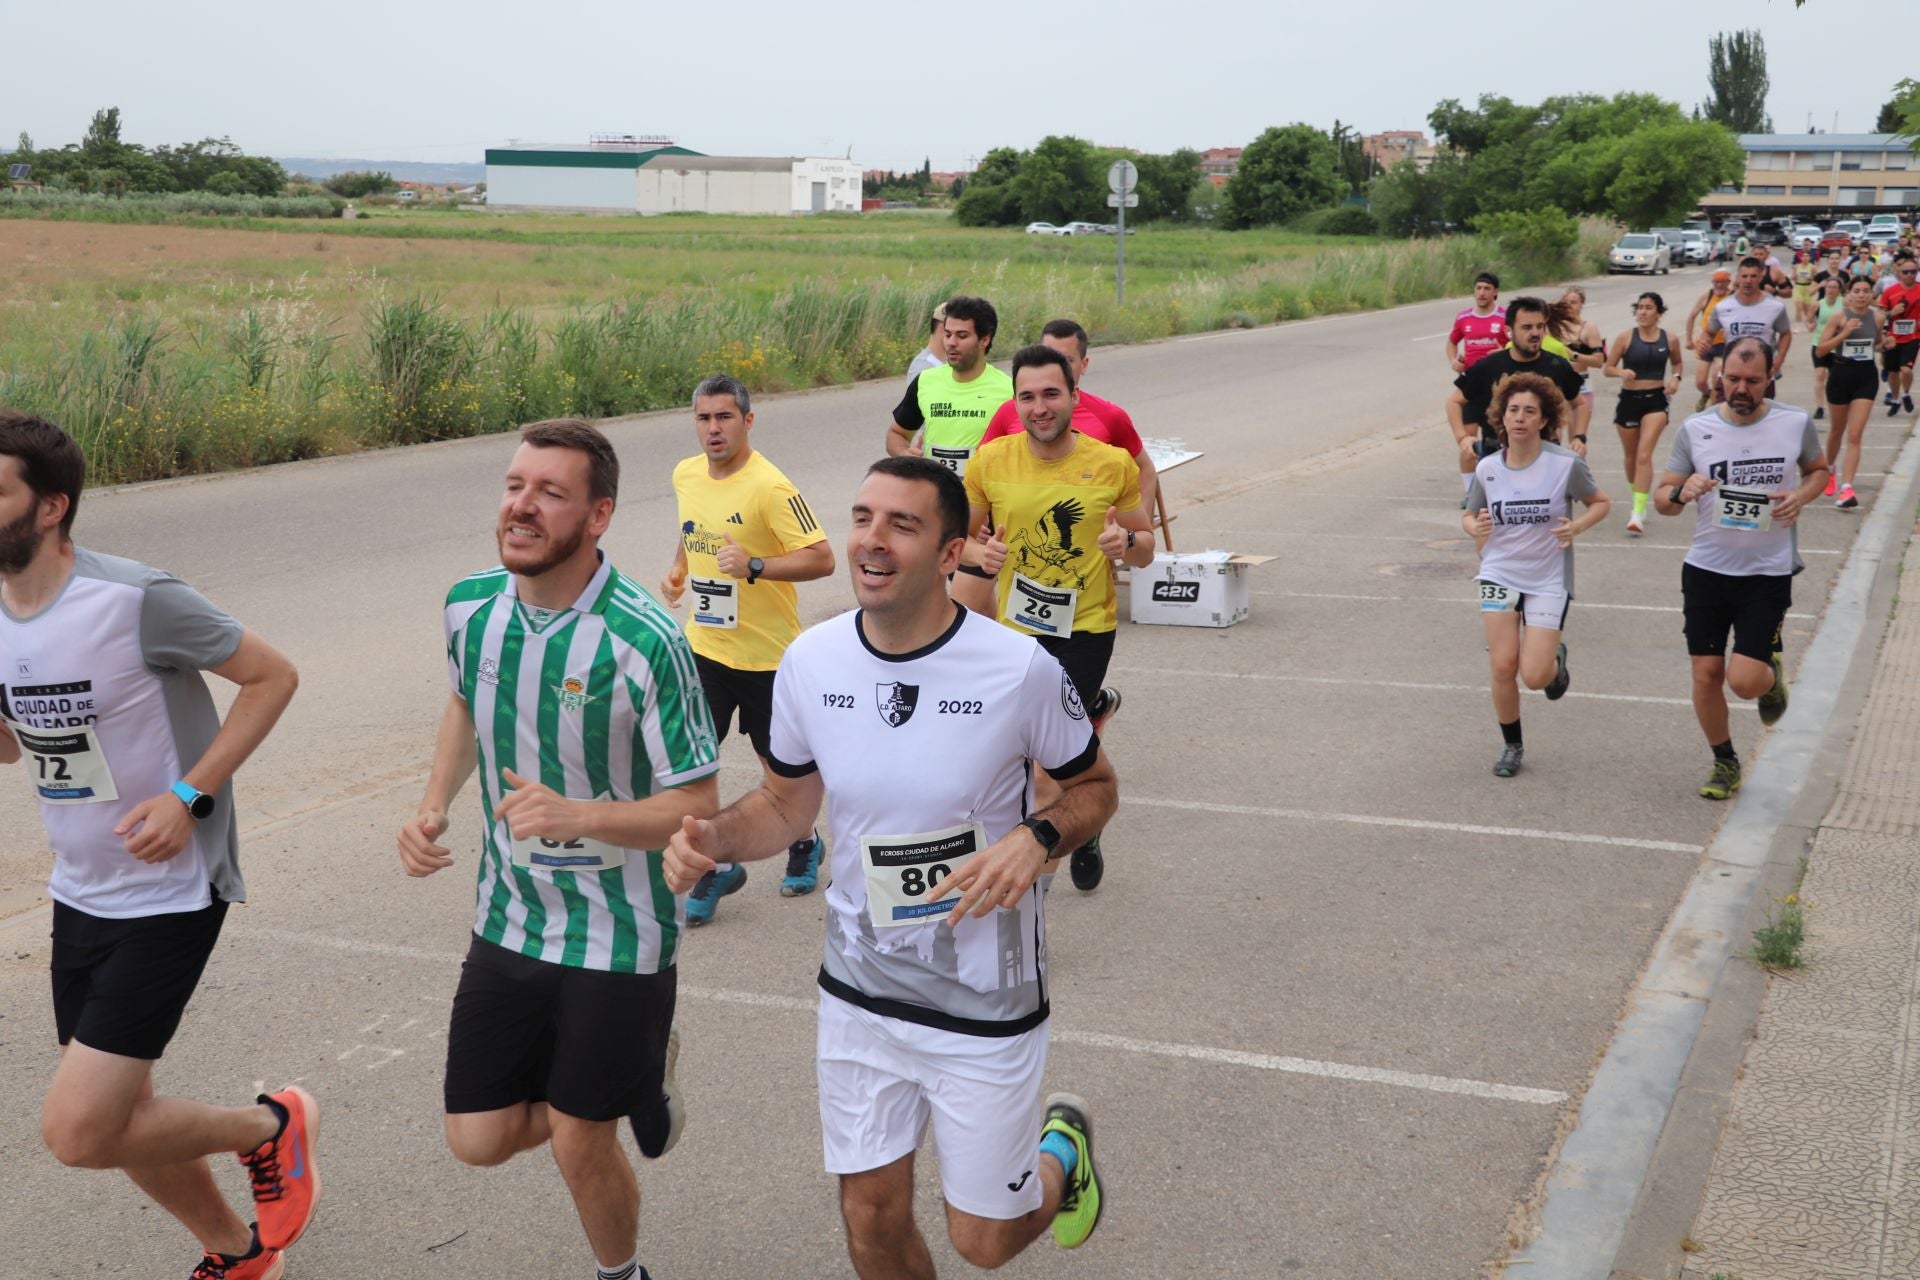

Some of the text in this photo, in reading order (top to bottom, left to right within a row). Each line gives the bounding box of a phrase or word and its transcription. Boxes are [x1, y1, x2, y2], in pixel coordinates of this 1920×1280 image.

[930, 402, 952, 410] CURSA
[1732, 465, 1773, 476] CIUDAD
[1732, 474, 1784, 486] ALFARO
[1504, 506, 1540, 515] CIUDAD
[1723, 501, 1761, 518] 534
[1507, 515, 1551, 525] ALFARO
[690, 540, 718, 556] WORLD
[1155, 585, 1197, 598] 42K
[699, 595, 710, 611] 3
[1024, 598, 1052, 619] 26
[15, 698, 94, 715] CIUDAD DE
[822, 693, 855, 709] 1922
[891, 704, 913, 712] ALFARO
[938, 700, 983, 715] 2022
[33, 754, 73, 781] 72
[904, 847, 929, 856] CIUDAD
[930, 845, 940, 853] DE
[940, 839, 965, 851] ALFARO
